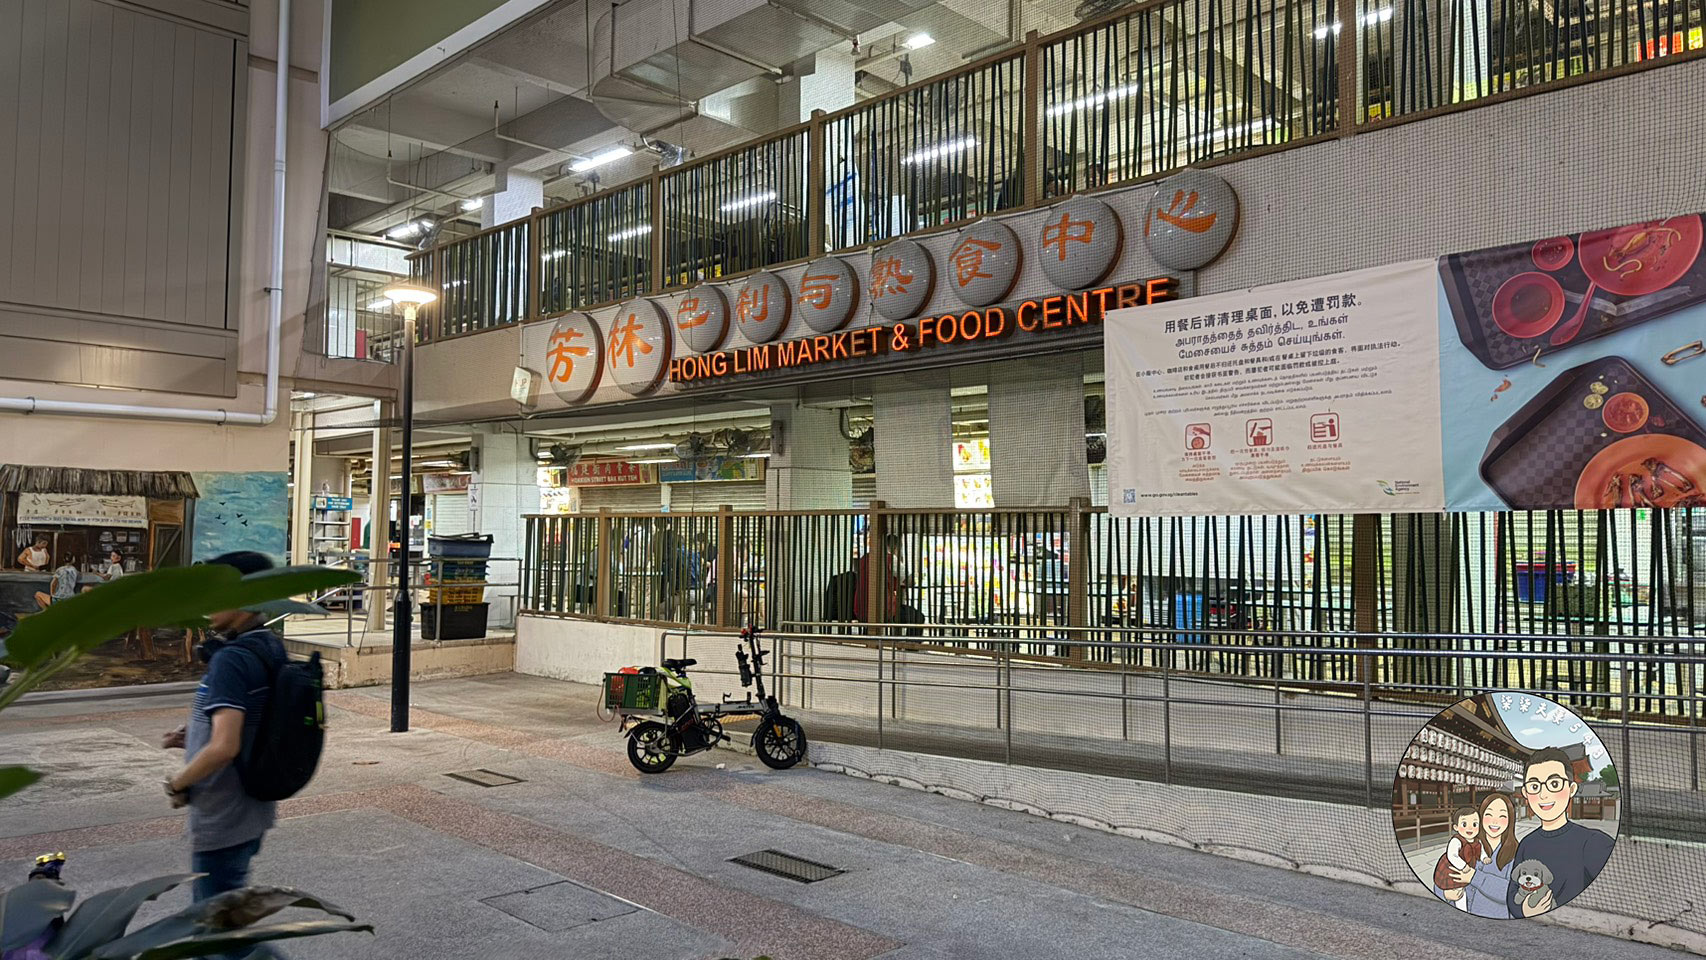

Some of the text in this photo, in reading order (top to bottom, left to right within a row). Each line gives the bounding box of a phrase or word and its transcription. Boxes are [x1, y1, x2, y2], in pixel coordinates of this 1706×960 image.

[669, 277, 1170, 383] HONG LIM MARKET & FOOD CENTRE
[1308, 313, 1348, 328] உங்கள்
